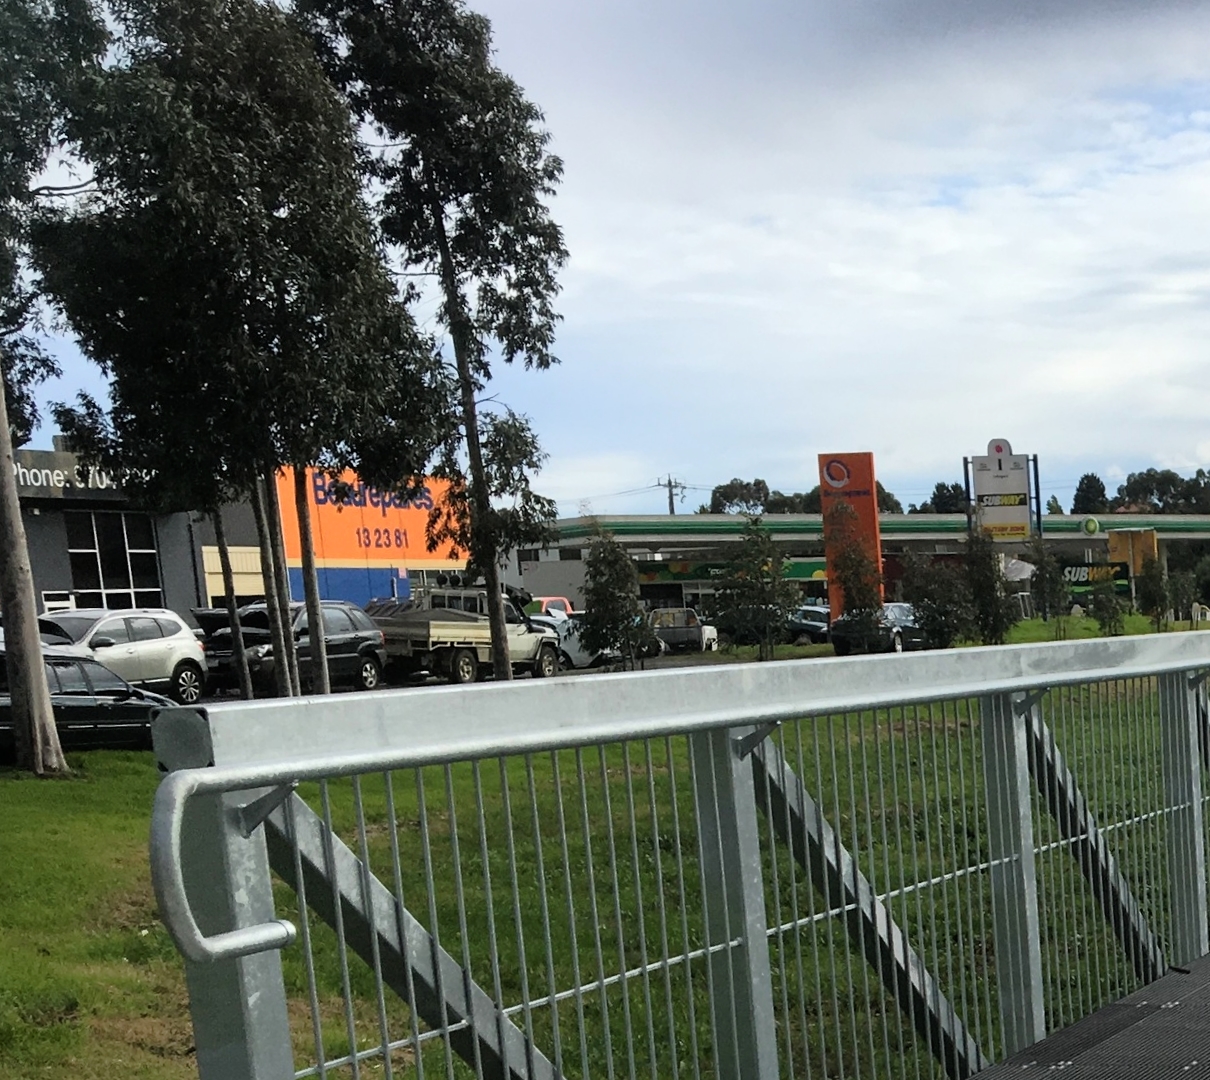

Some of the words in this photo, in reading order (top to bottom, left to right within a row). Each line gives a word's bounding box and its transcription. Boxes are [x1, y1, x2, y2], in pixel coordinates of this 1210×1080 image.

[981, 494, 1025, 507] SUBWAY
[356, 528, 371, 548] 13
[374, 528, 392, 548] 23
[395, 528, 409, 549] 81
